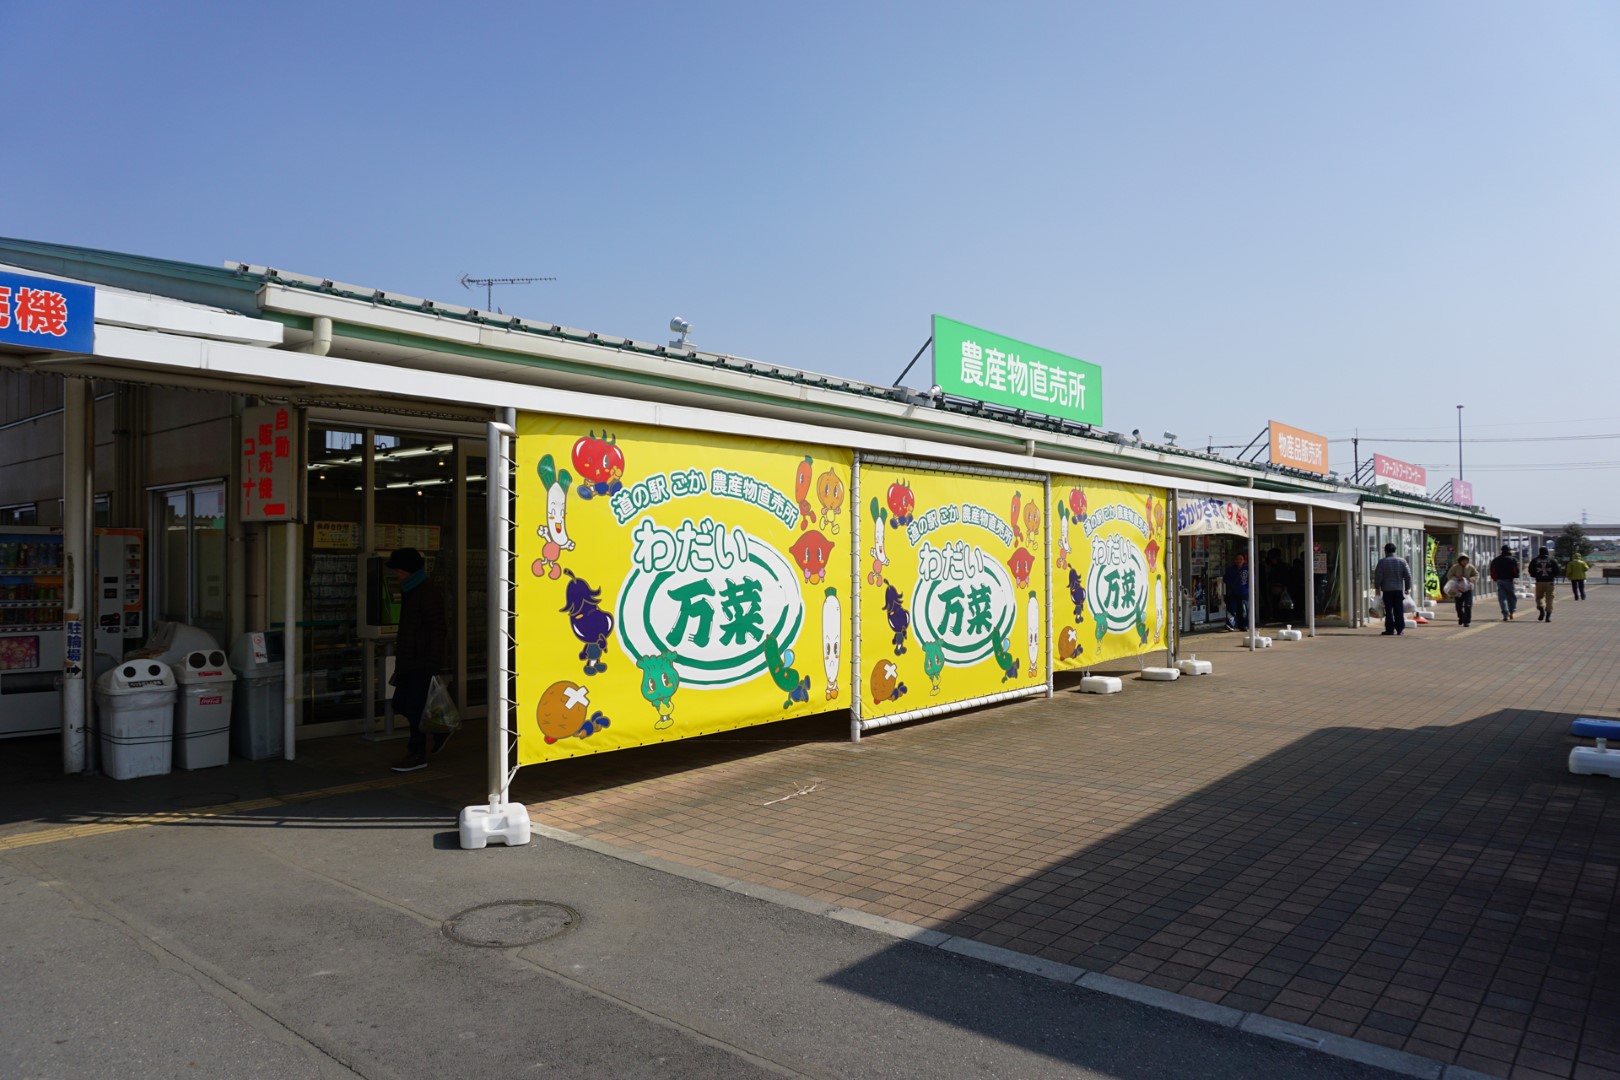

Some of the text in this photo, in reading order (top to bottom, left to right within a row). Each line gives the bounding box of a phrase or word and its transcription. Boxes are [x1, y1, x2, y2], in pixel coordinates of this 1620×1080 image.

[0, 286, 68, 337] 機
[960, 340, 1086, 411] 農産物直売所
[275, 408, 289, 458] 自動
[1278, 432, 1323, 467] 物産品販売所
[243, 438, 256, 515] コーナー
[258, 424, 273, 499] 販売機
[612, 470, 799, 529] 道の駅 ごか 農産物直売所
[633, 519, 749, 573] わだい
[907, 509, 939, 546] 道の駅
[961, 504, 1013, 547] 農産物直売所
[1092, 535, 1131, 566] わだい
[918, 542, 984, 581] わだい
[666, 576, 764, 648] 万菜
[937, 585, 993, 636] 万菜
[1103, 569, 1136, 610] 万菜
[67, 621, 82, 662] 駐輪場
